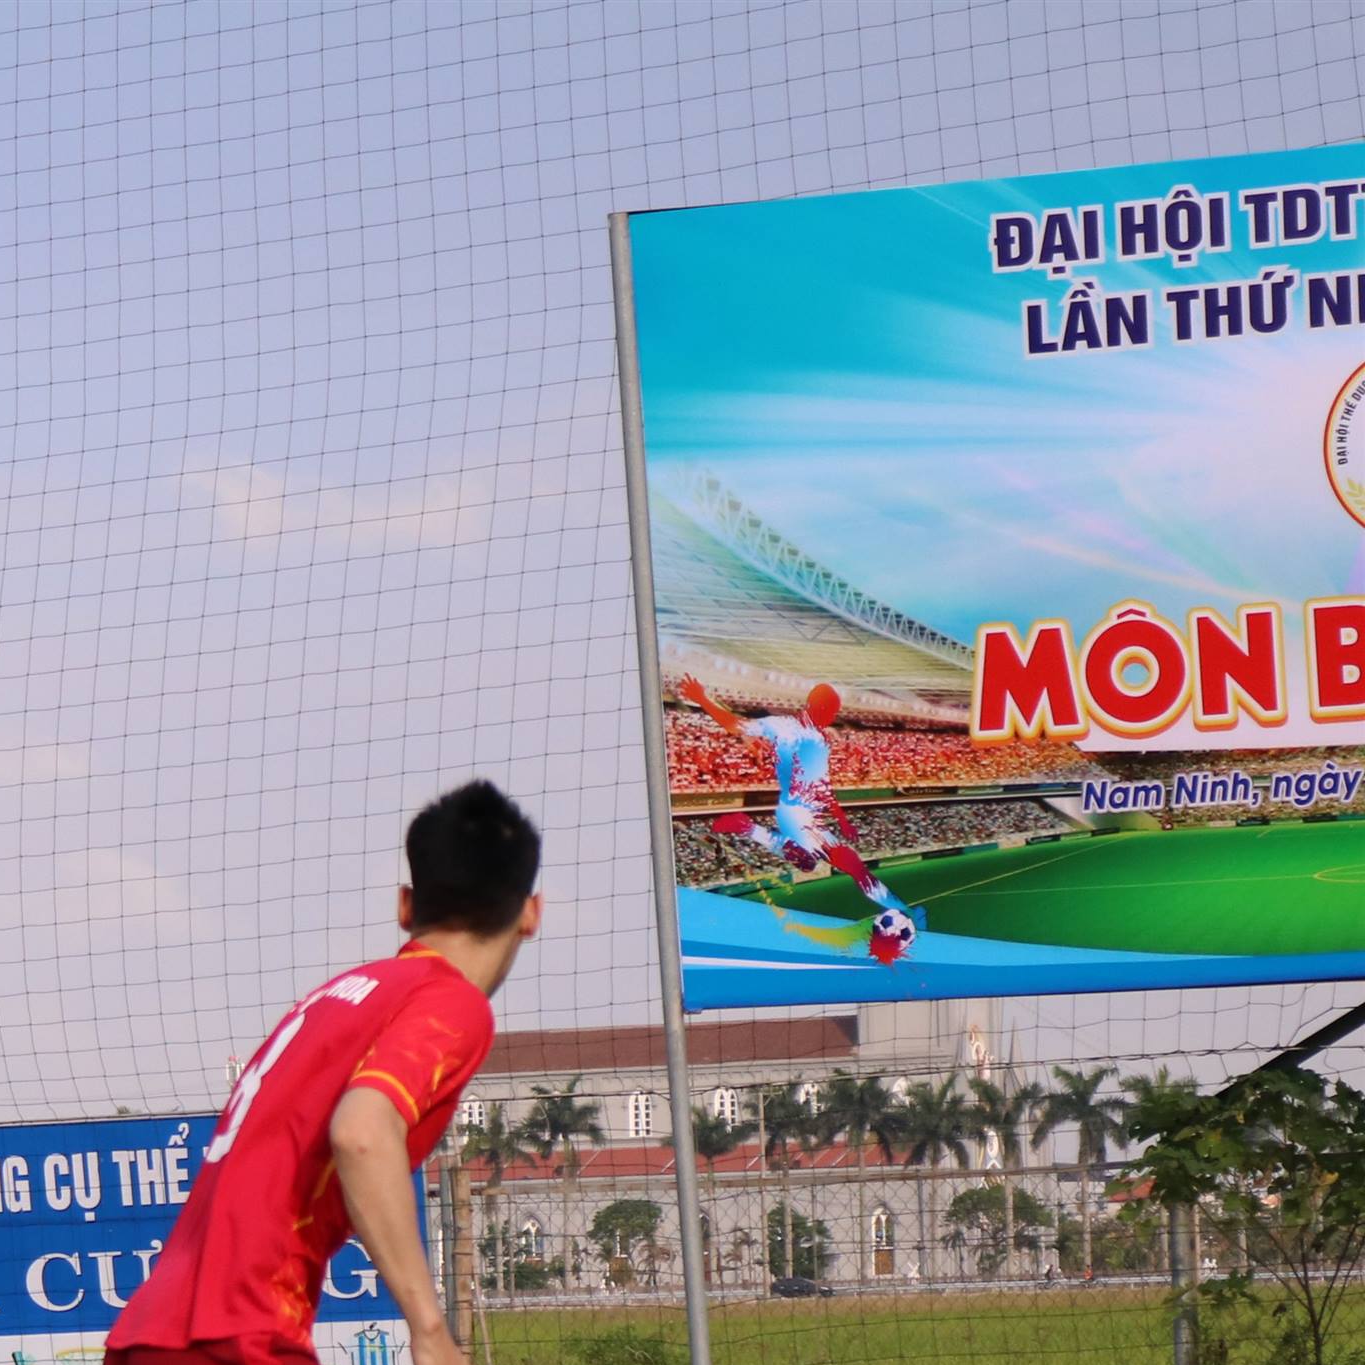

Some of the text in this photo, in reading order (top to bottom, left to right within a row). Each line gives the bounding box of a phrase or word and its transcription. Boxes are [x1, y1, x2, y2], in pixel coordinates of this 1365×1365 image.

[992, 182, 1365, 276] ĐẠI HỘI TDT
[1025, 269, 1365, 356] LẦN THỨ N
[976, 604, 1283, 738] MÔN
[1083, 761, 1363, 811] Nam Ninh, ngày
[43, 1151, 101, 1222] CỤ
[111, 1122, 191, 1207] THỂ
